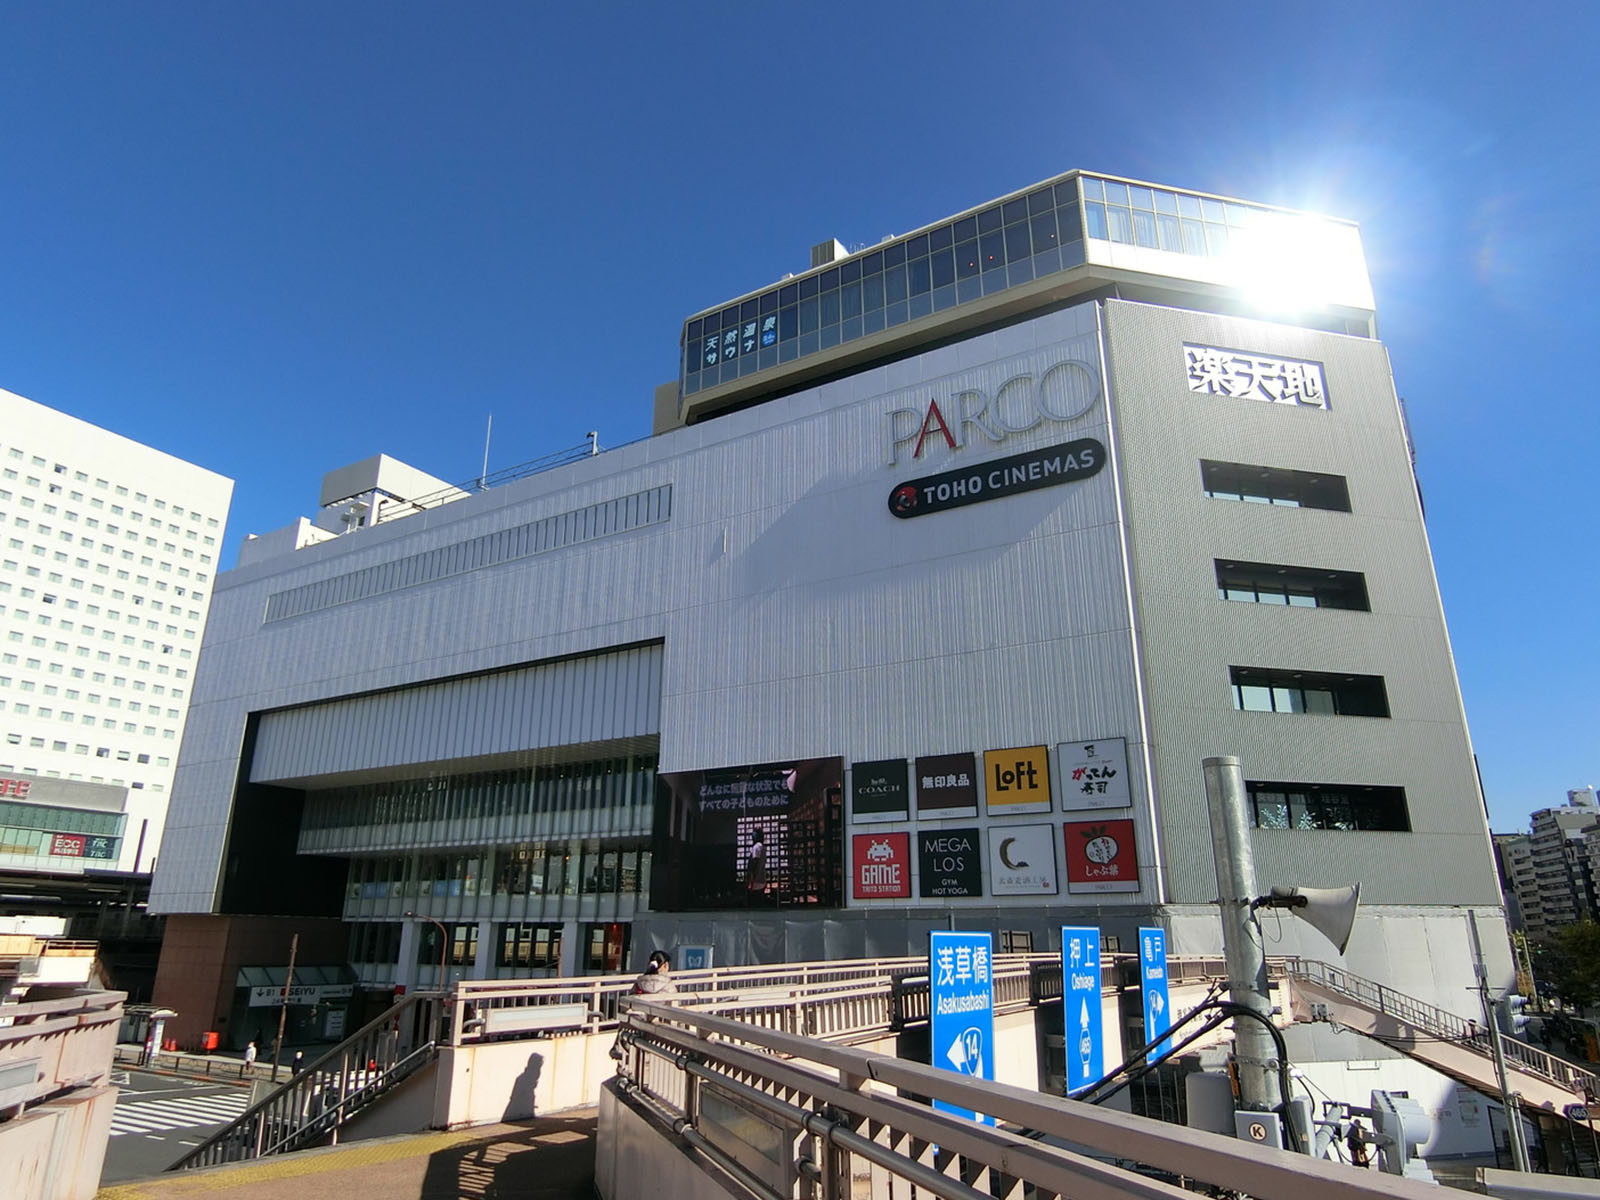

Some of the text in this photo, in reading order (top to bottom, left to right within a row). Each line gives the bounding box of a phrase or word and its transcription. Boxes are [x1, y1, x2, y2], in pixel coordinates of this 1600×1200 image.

[705, 316, 776, 352] 天然温泉
[706, 339, 755, 365] サウナ
[1187, 349, 1323, 407] 楽天地
[885, 360, 1099, 465] PARCO
[923, 449, 1094, 504] TOHO CINEMAS
[858, 784, 900, 795] COACH
[922, 773, 970, 789] 無印良品
[1081, 781, 1108, 795] 寿司
[55, 840, 80, 849] ECC
[925, 837, 971, 853] MEGA
[861, 864, 900, 885] GAME
[934, 857, 964, 872] LOS
[948, 887, 968, 895] YOGA
[1070, 936, 1095, 968] 押上
[1144, 937, 1162, 962] 亀戸
[937, 945, 988, 986] 浅草橋
[1071, 973, 1095, 991] Oshiage
[937, 989, 990, 1015] Asakusabashi
[966, 1033, 978, 1060] 14
[1252, 1126, 1264, 1138] K
